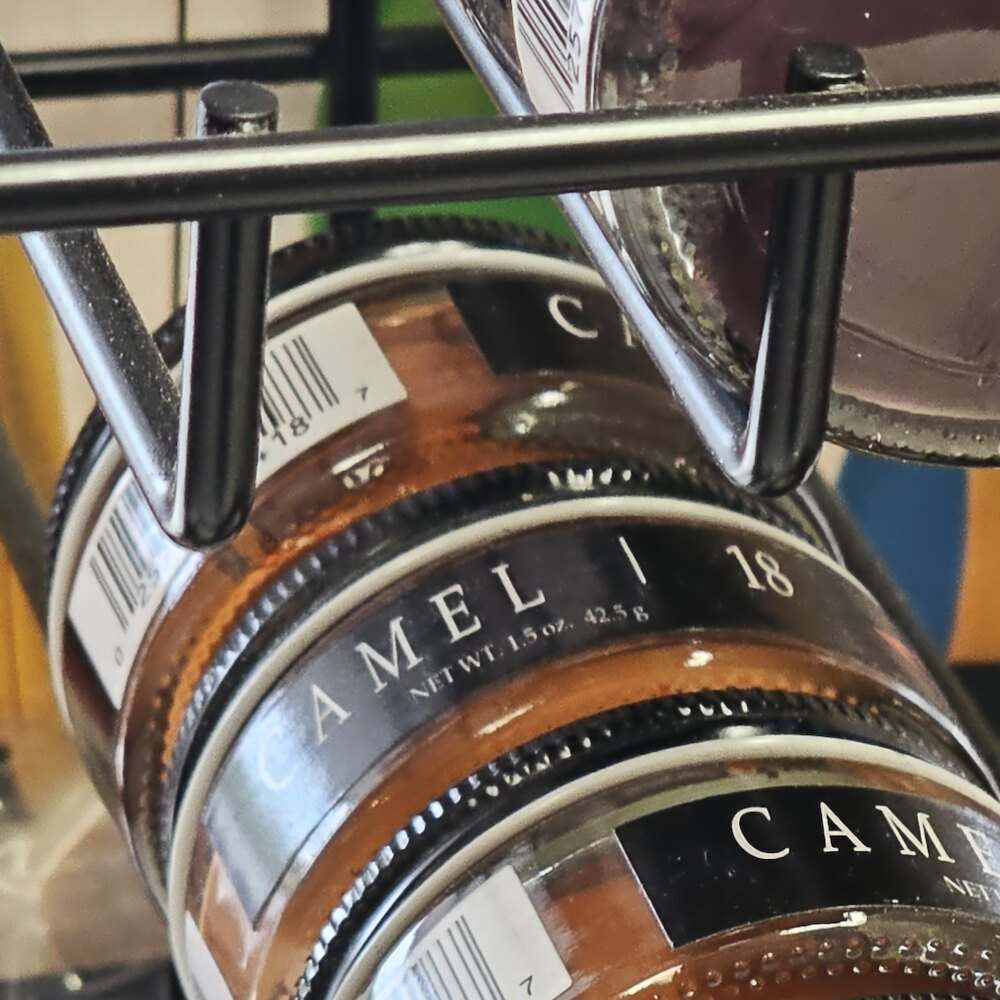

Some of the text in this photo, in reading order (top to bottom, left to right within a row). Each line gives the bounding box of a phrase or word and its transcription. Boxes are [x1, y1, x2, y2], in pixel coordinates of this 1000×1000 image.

[256, 561, 546, 790] CAMEL
[726, 544, 795, 598] 18
[409, 665, 454, 704] NET
[457, 642, 504, 673] WT.
[507, 627, 538, 652] 1.5
[584, 604, 628, 625] 42.5
[518, 974, 535, 997] 7
